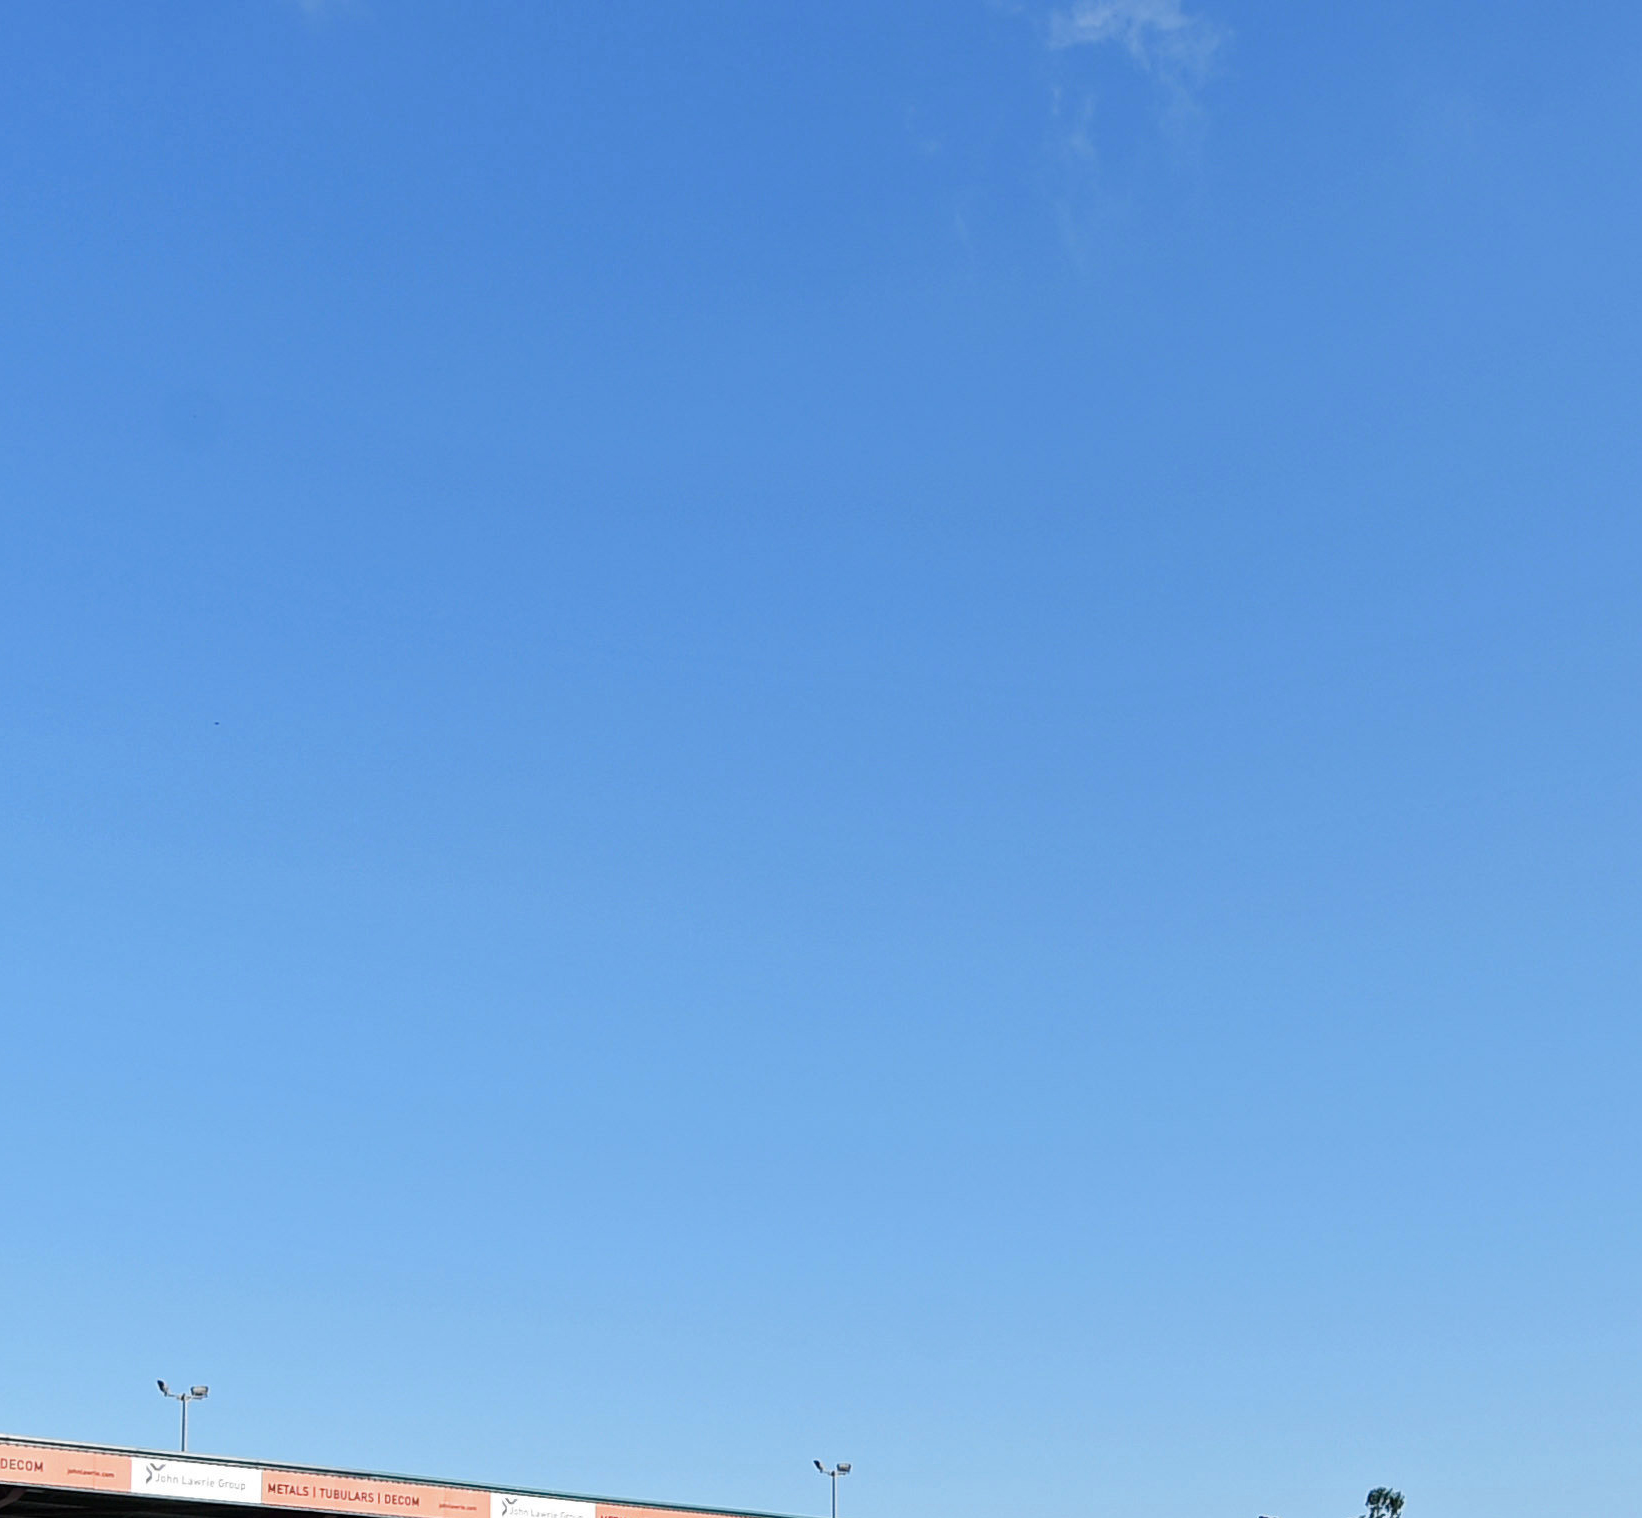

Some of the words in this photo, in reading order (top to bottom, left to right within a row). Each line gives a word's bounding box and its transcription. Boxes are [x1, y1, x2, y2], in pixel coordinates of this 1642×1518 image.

[0, 1458, 44, 1473] DECOM
[154, 1472, 179, 1484] John
[181, 1475, 215, 1487] Lawrie
[218, 1478, 246, 1491] Group
[268, 1483, 309, 1497] METALS
[320, 1488, 375, 1503] TUBULARS
[384, 1495, 420, 1507] DECOM
